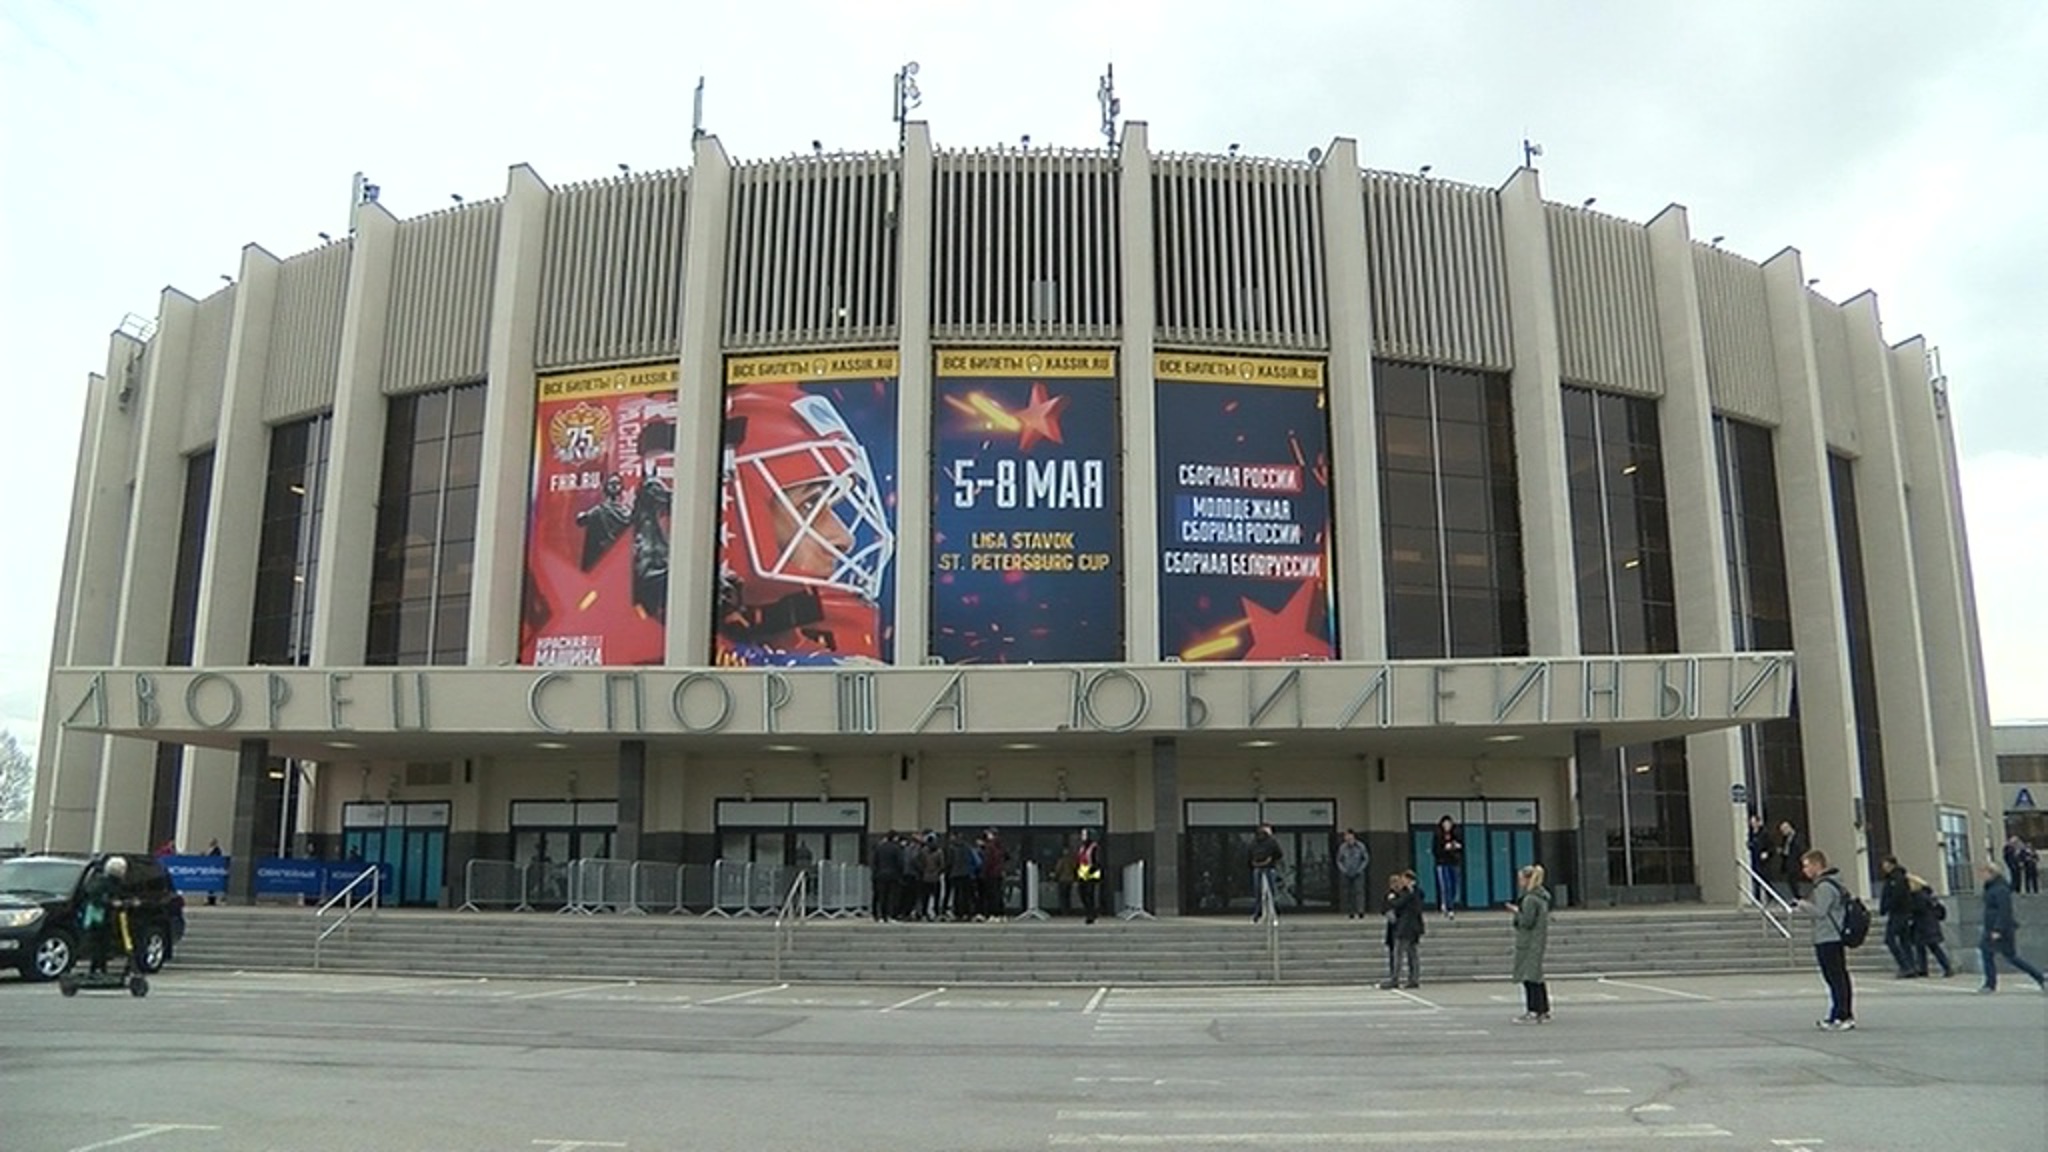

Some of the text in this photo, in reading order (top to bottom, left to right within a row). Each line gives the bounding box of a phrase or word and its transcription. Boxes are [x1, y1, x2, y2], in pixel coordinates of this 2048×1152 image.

[733, 358, 893, 378] ВСЕ БИЛЕТЫ KASSIR.RU
[943, 357, 1109, 370] ВСЕ БИЛЕТЫ KASSIR.RU
[1159, 360, 1318, 380] ВСЕ БИЛЕТЫ KASSIR.RU
[543, 382, 563, 396] ВСЕ
[566, 377, 611, 393] БИЛЕТЫ
[566, 426, 594, 450] 75
[954, 459, 1104, 509] 5-8 МАЯ
[1179, 464, 1297, 490] СБОРНАЯ РОССИИ
[1193, 497, 1291, 521] МОЛОДЕЖНАЯ
[971, 532, 1075, 550] LIGA STAVOK
[1182, 520, 1301, 545] СБОРНАЯ РОССИИ
[938, 553, 1111, 571] ST. PETERSBURG CUP
[1164, 551, 1321, 578] СБОРНАЯ БЕЛОРУССИИ
